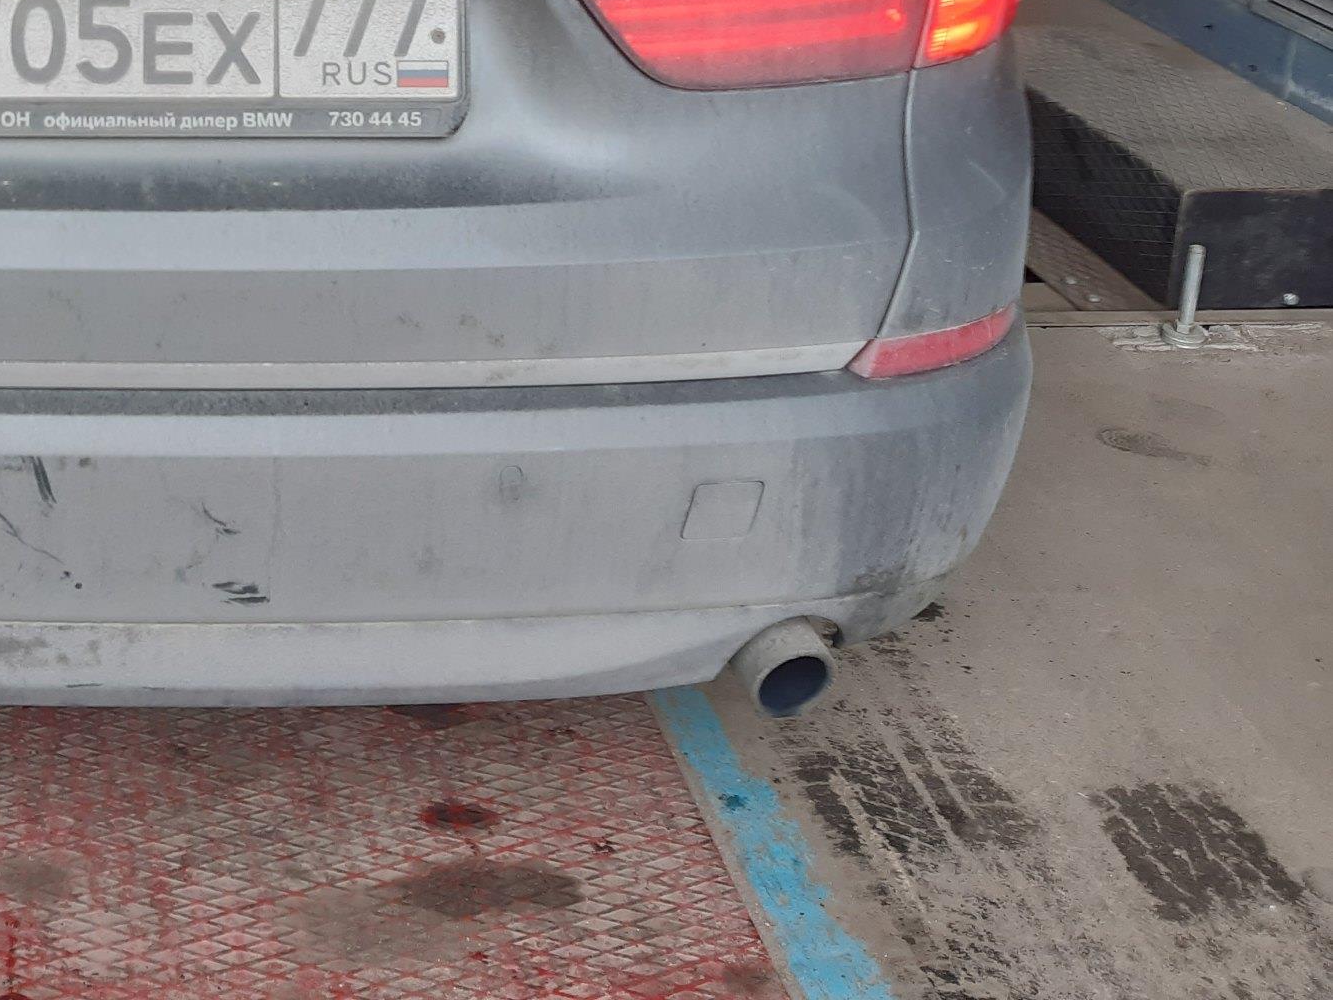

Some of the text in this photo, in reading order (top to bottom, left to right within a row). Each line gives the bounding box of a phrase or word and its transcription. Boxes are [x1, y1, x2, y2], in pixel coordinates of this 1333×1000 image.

[322, 61, 392, 86] RUS
[43, 112, 176, 131] официальный
[179, 115, 238, 131] дилер
[242, 112, 293, 128] BMW
[328, 111, 364, 127] 730
[368, 111, 393, 127] 44
[397, 111, 422, 127] 45
